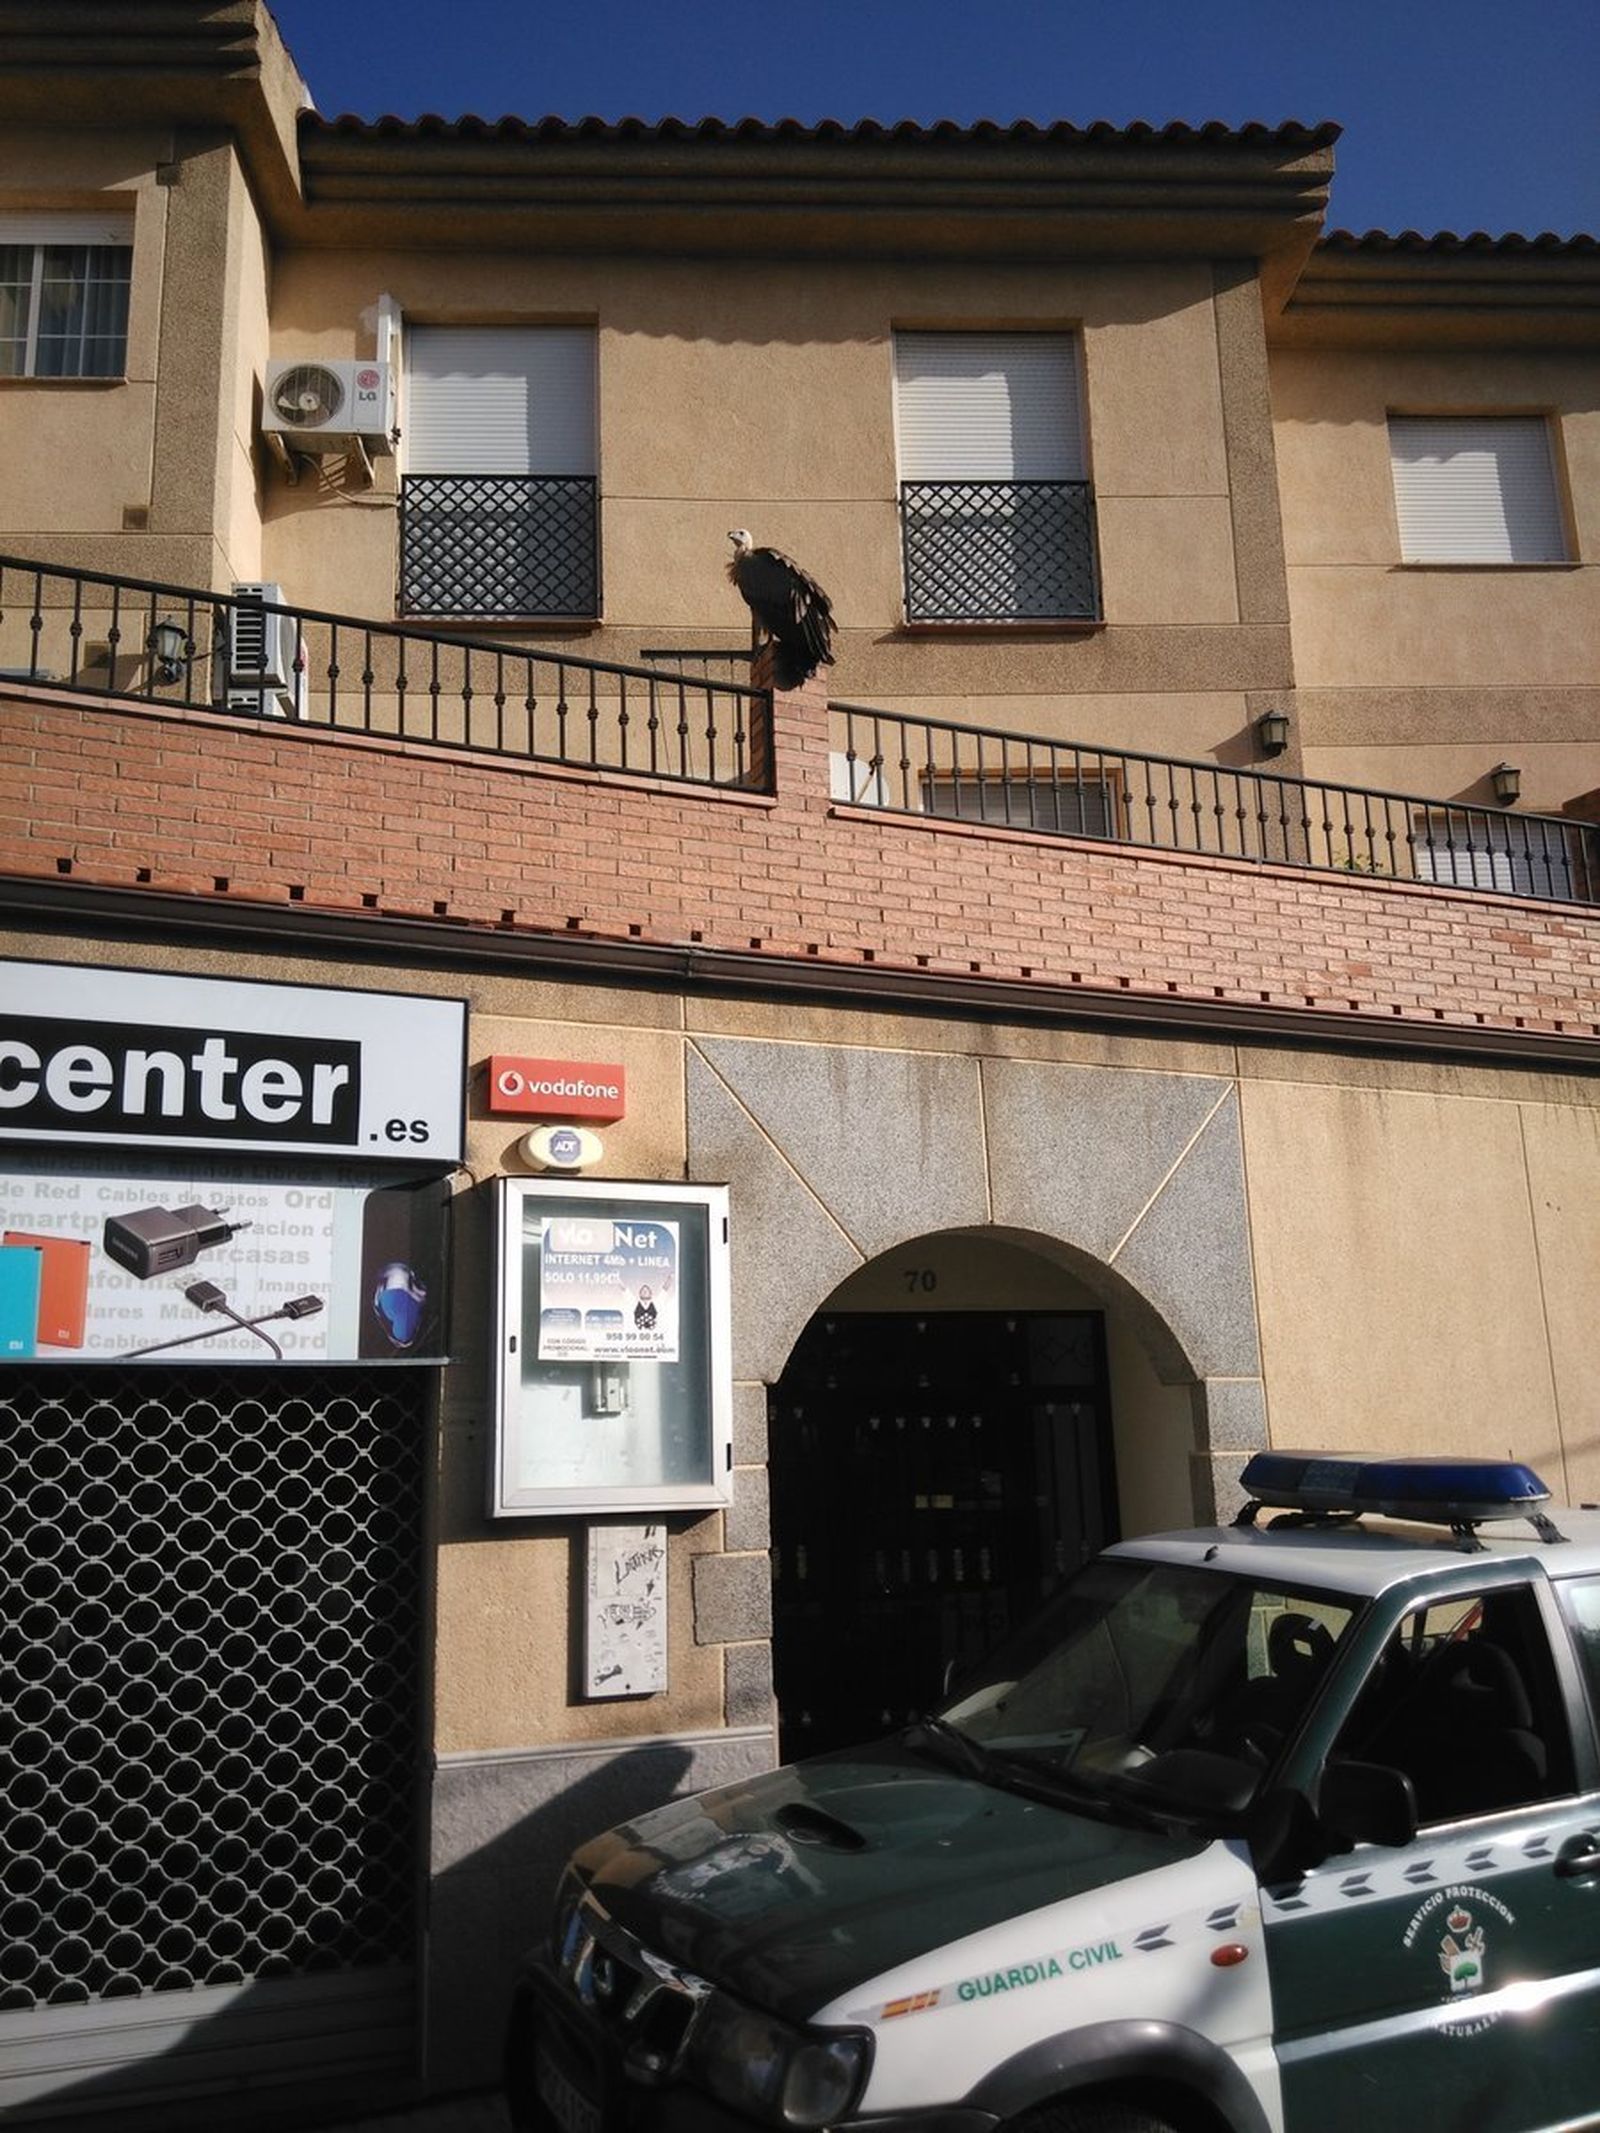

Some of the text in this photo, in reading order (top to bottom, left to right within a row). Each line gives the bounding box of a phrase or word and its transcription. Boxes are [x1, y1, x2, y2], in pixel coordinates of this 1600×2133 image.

[358, 391, 377, 401] LG
[0, 1037, 430, 1142] center .es
[528, 1079, 619, 1100] vodafone
[554, 1139, 578, 1153] ADT
[34, 1182, 81, 1200] Red
[97, 1186, 170, 1205] Cables
[209, 1191, 269, 1208] Datos
[284, 1189, 332, 1210] Ord
[614, 1226, 658, 1249] Net
[545, 1254, 600, 1266] INTERNET
[637, 1256, 670, 1268] LINEA
[545, 1272, 575, 1284] SOLO
[903, 1269, 937, 1293] 70
[278, 1330, 327, 1350] Ord
[1402, 1885, 1516, 1948] SERVICIO PROTECCION
[957, 1940, 1123, 2001] GUARDIA CIVIL
